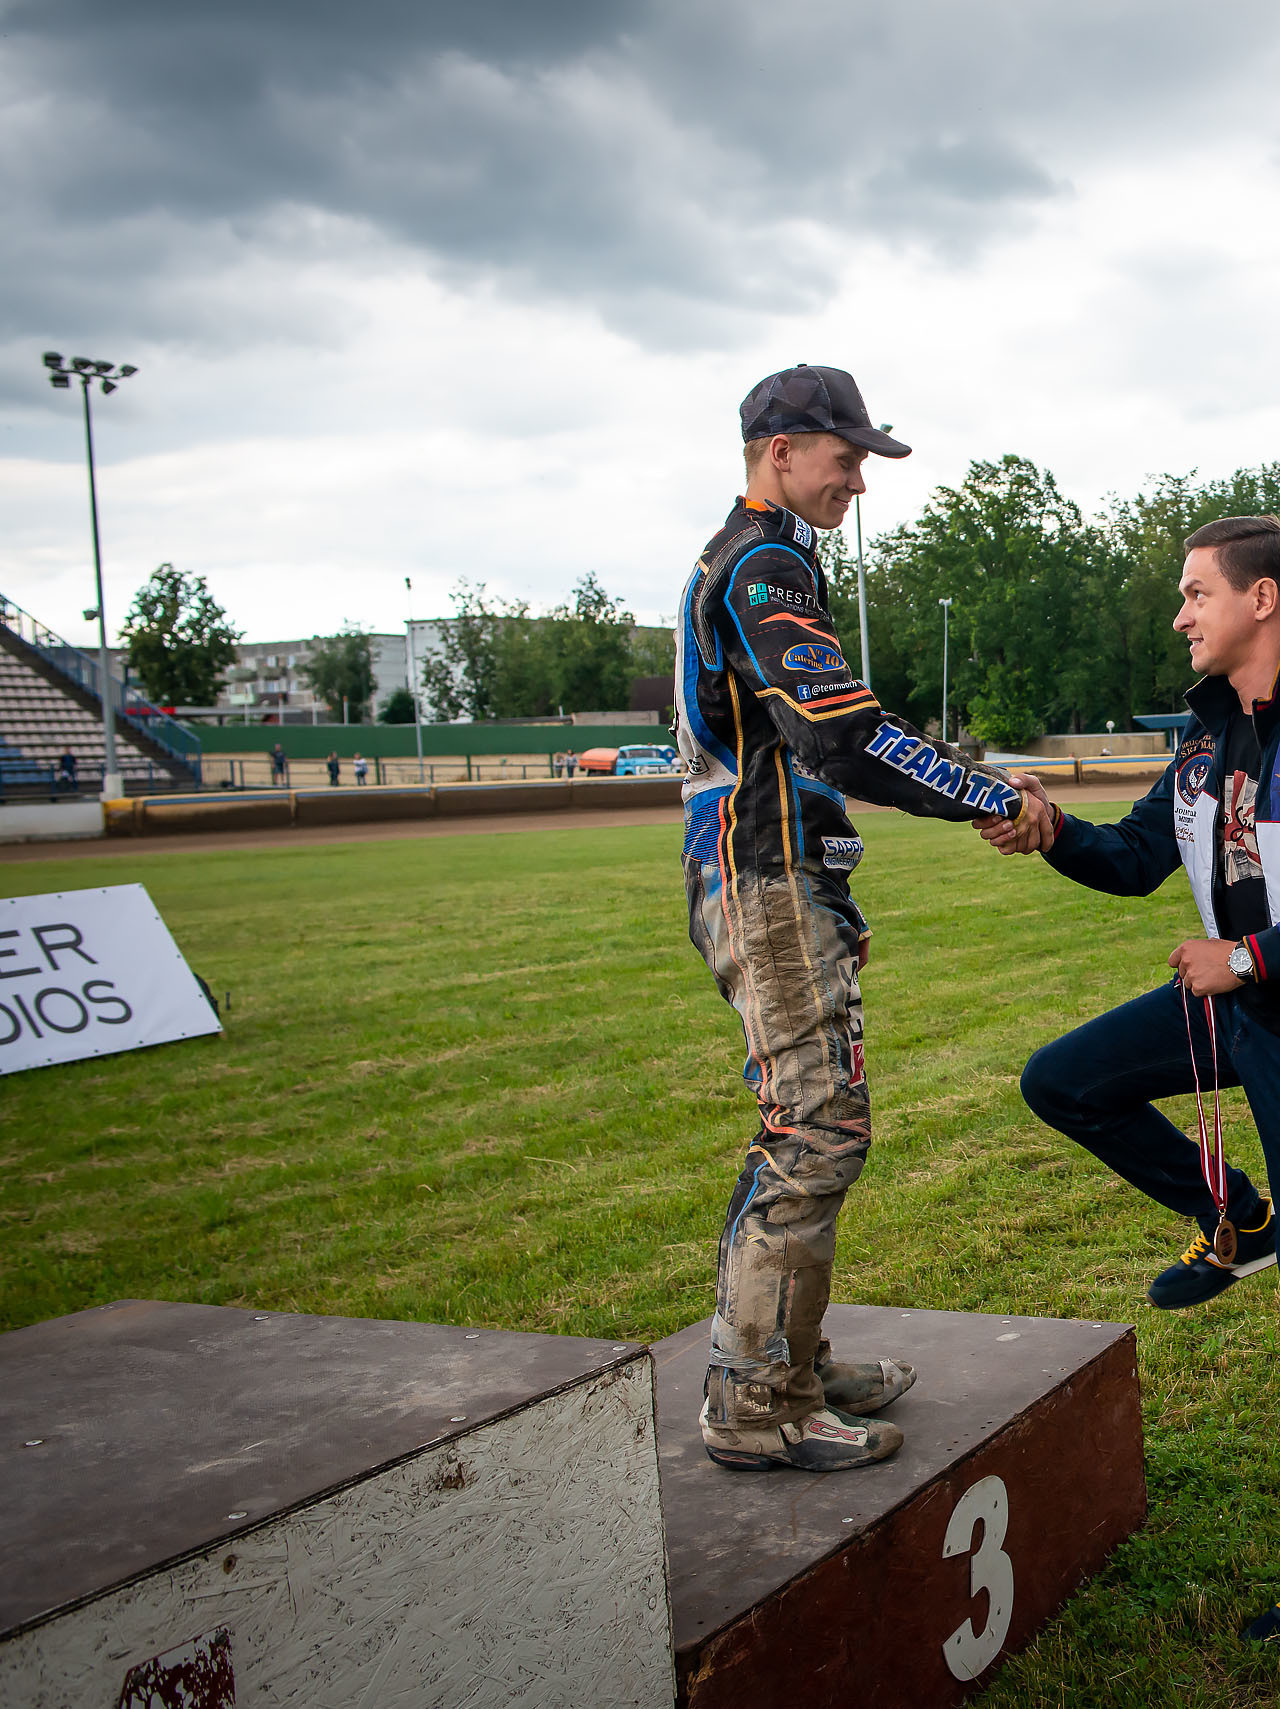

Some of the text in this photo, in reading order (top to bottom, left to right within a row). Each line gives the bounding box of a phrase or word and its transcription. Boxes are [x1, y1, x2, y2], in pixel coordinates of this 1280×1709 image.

[787, 652, 824, 671] Catering
[825, 653, 840, 667] 10
[864, 720, 1019, 817] TEAM TK
[942, 1475, 1014, 1682] 3
